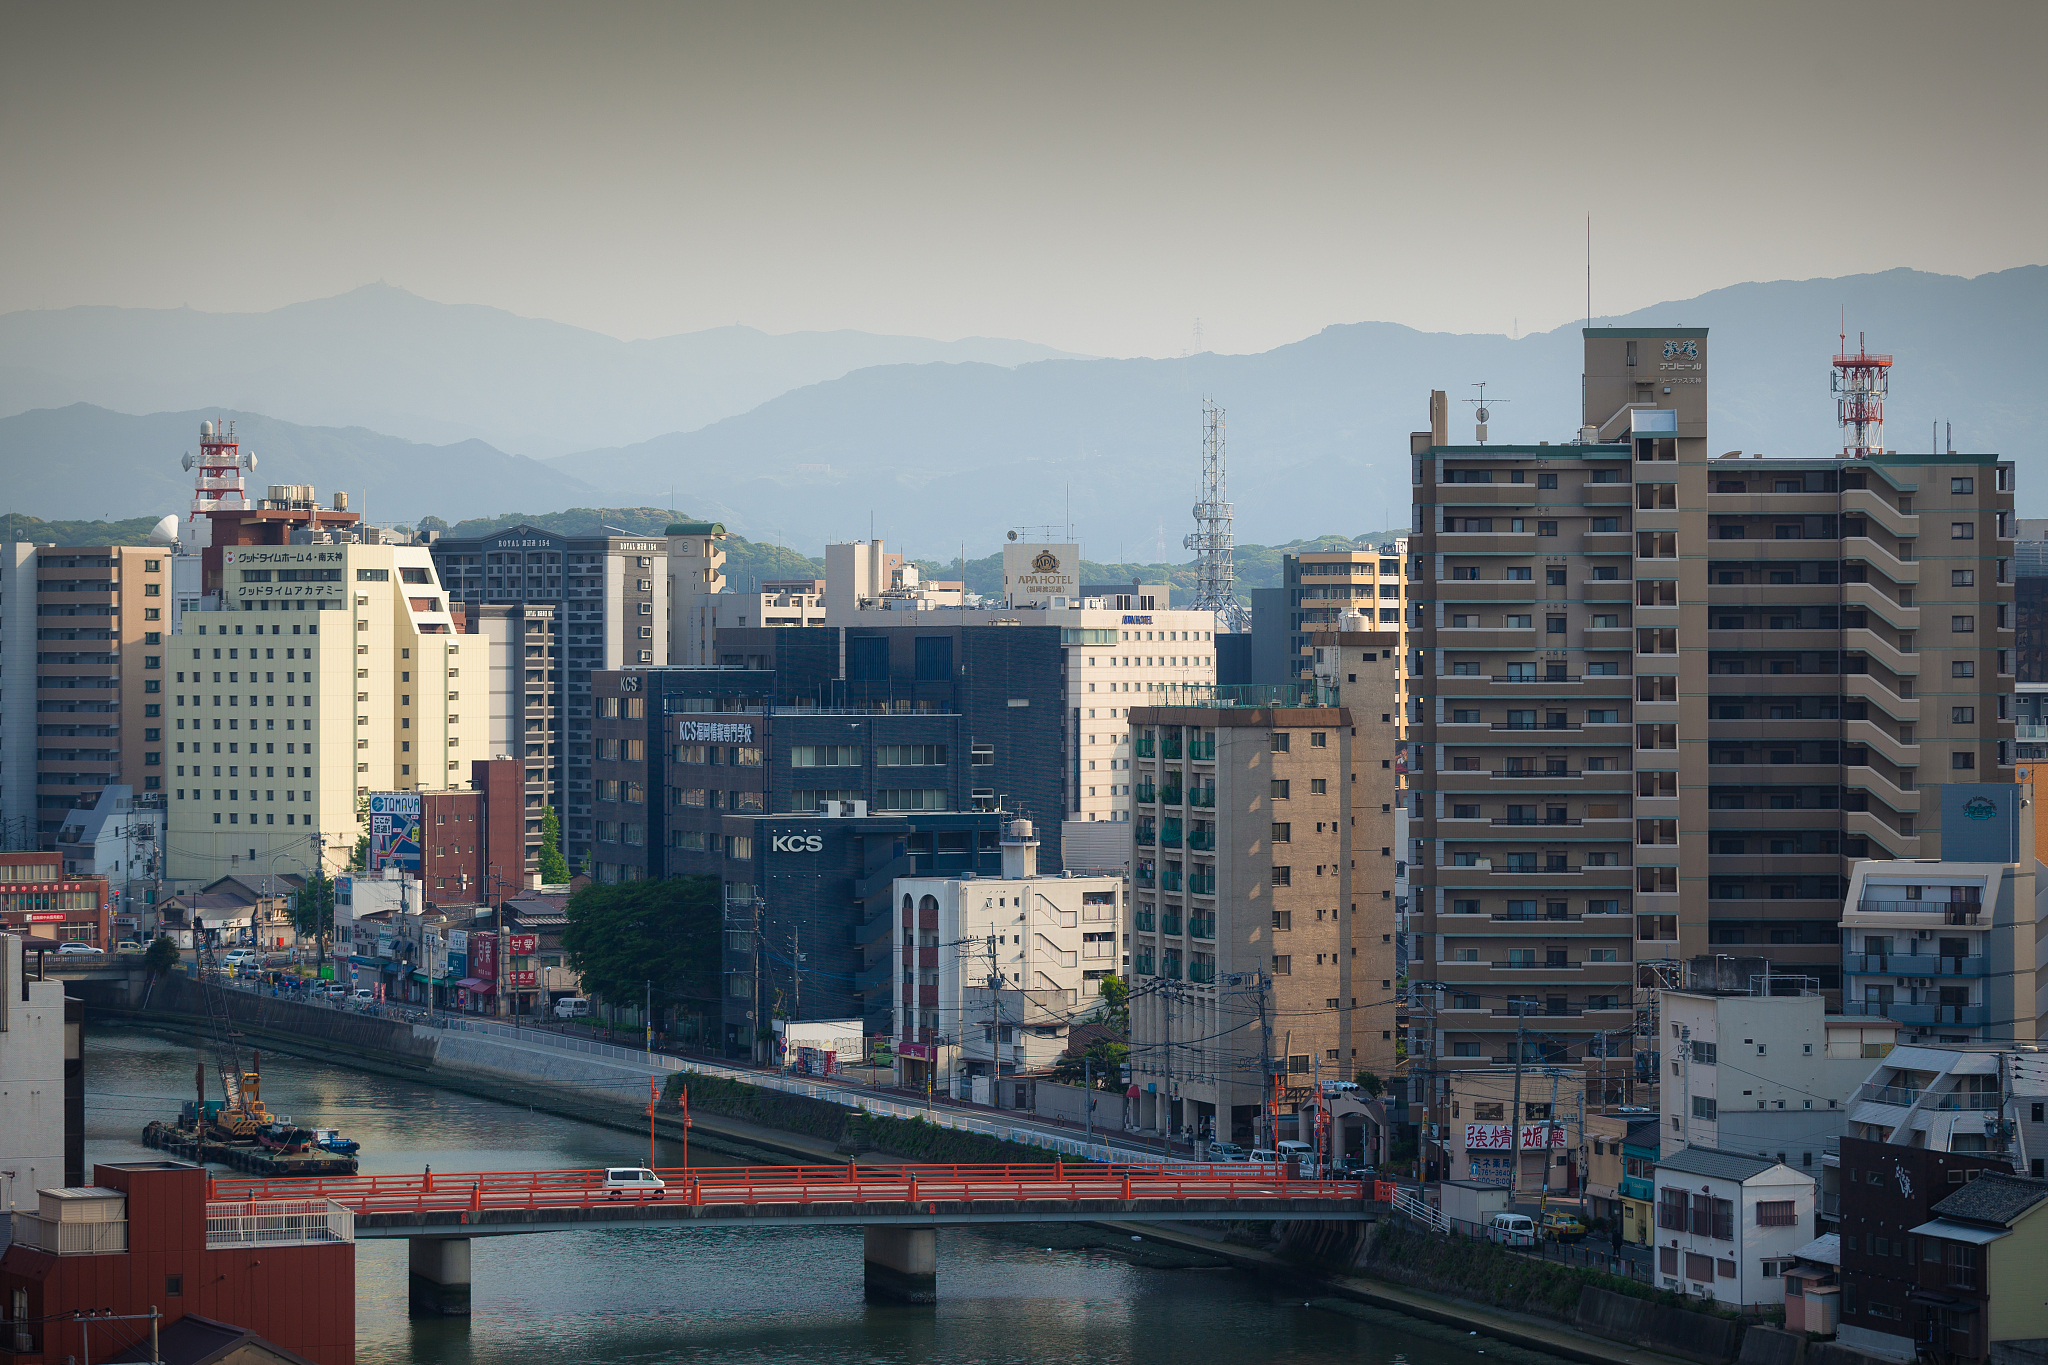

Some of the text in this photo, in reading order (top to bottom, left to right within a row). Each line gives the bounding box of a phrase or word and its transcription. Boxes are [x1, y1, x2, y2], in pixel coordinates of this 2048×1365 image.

[1036, 557, 1056, 567] APA
[1017, 575, 1074, 585] APA HOTEL
[238, 585, 344, 596] グッドタイムアカデミー
[620, 676, 638, 692] KCS
[679, 721, 753, 743] KCS福岡情報専門学校
[374, 817, 391, 825] ここが
[772, 835, 823, 853] KCS
[1466, 1125, 1513, 1149] 強精
